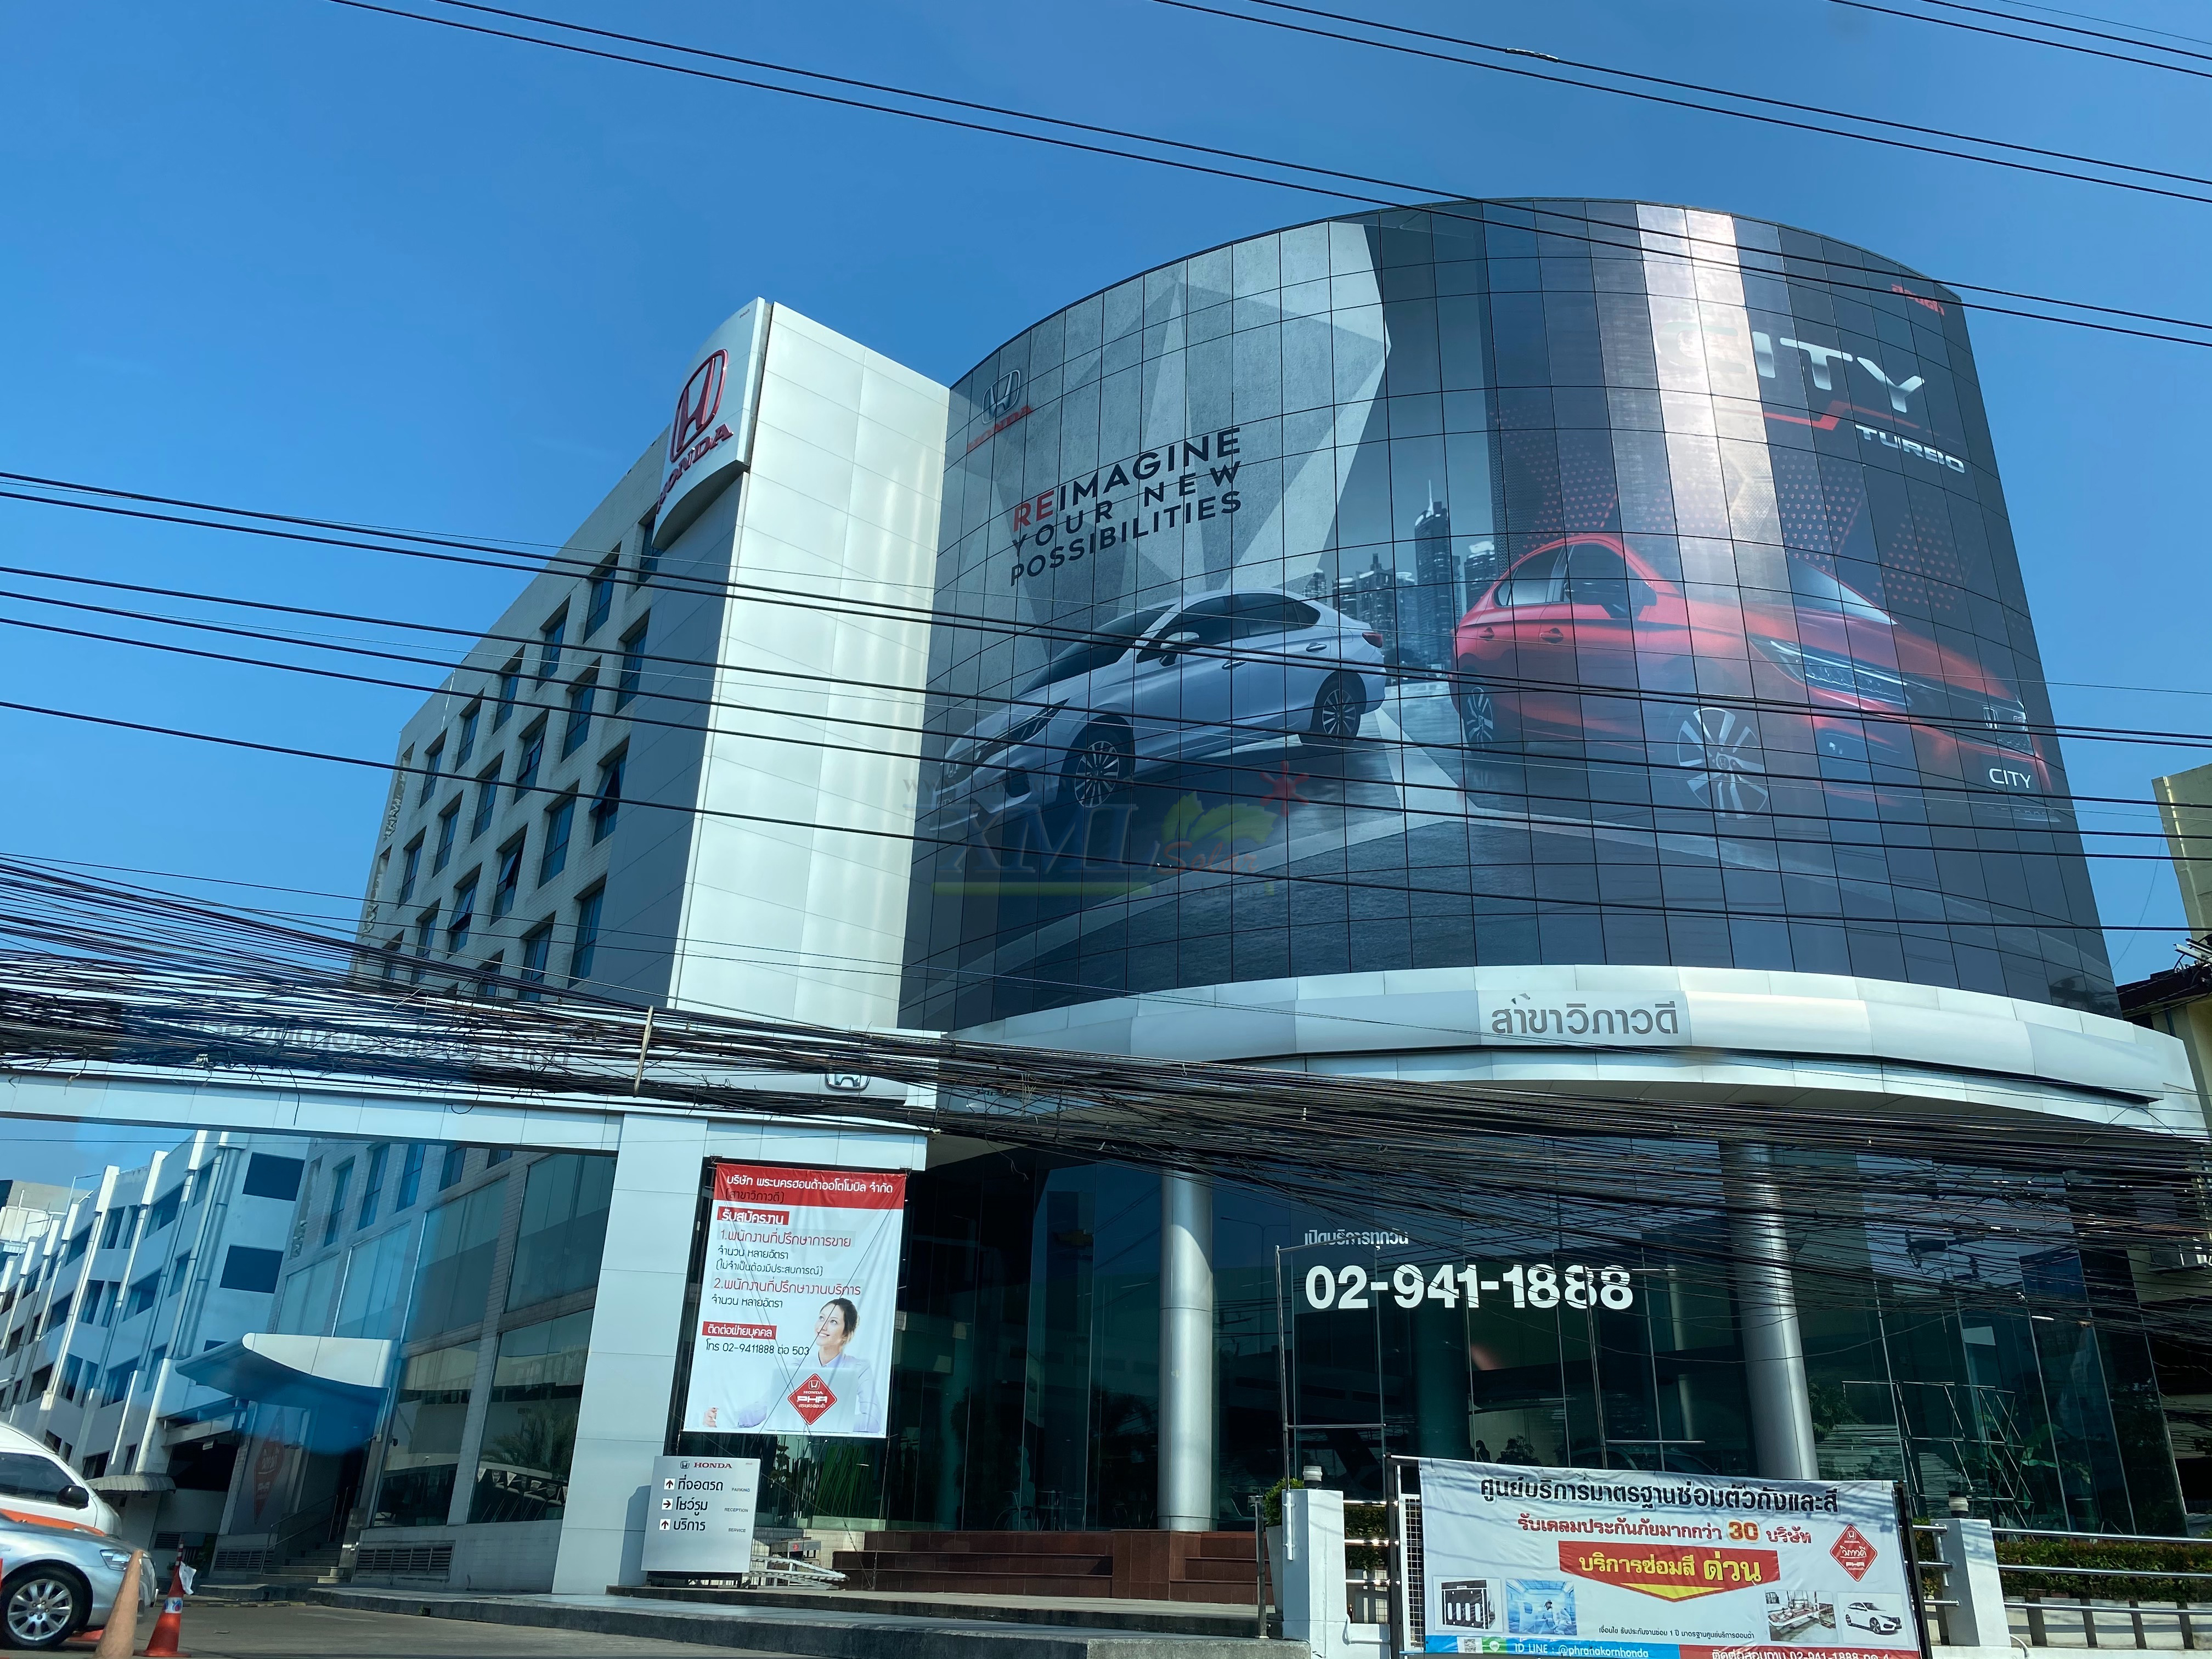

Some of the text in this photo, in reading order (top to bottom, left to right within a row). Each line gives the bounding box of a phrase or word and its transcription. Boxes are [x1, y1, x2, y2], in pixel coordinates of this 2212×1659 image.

[1855, 424, 1965, 474] TURBO
[656, 423, 734, 515] HONDA
[1013, 427, 1241, 532] REIMAGINE
[1012, 461, 1240, 557] YOUR NEW
[1011, 490, 1242, 587] POSSIBILITIES
[1989, 768, 2031, 788] CITY
[727, 1174, 753, 1186] บริษัท
[870, 1182, 893, 1193] จำกัด
[721, 1208, 784, 1224] รับสมัครงาน
[718, 1245, 789, 1260] จำนวน หลายอัตรา
[1305, 1263, 1633, 1310] 02-941-1888
[711, 1294, 783, 1308] จำนวน หลายอัตรา
[707, 1324, 772, 1339] ติดต่อฝ่ายบุคคล
[706, 1338, 720, 1351] โทร
[723, 1342, 774, 1354] 02-9411888
[792, 1346, 810, 1356] 503
[678, 1475, 724, 1491] ที่จอดรถ
[675, 1497, 708, 1516] โชว์รูม
[673, 1518, 706, 1531] บริการ
[1728, 1521, 1759, 1542] 30
[1765, 1525, 1812, 1544] บริษัท
[1578, 1550, 1762, 1582] บริการซ่อมสี ด่วน
[1528, 1643, 1548, 1654] LINE
[1558, 1645, 1649, 1658] @phranakornhonda
